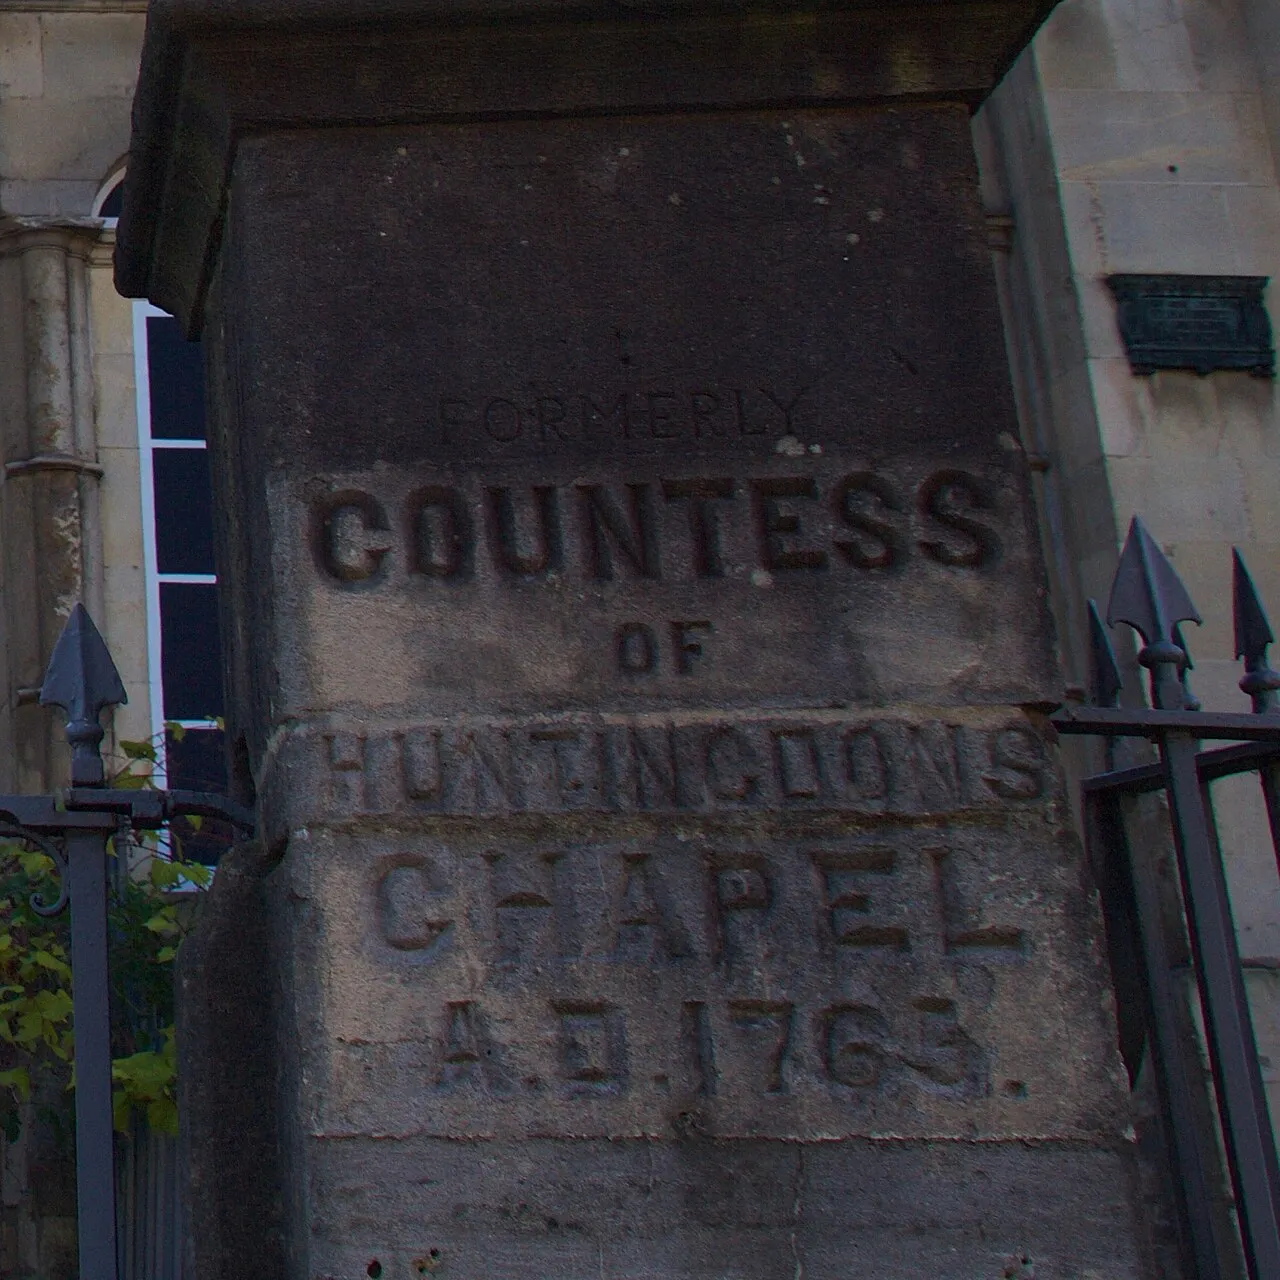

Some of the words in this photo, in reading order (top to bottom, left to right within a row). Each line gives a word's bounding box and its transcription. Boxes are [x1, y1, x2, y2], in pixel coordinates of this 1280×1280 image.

[439, 385, 814, 445] FORMERLY
[312, 468, 1004, 591] COUNTESS
[612, 618, 714, 677] OF
[320, 723, 1046, 812] HUNTINGDONS
[372, 849, 1026, 965] CHAPEL
